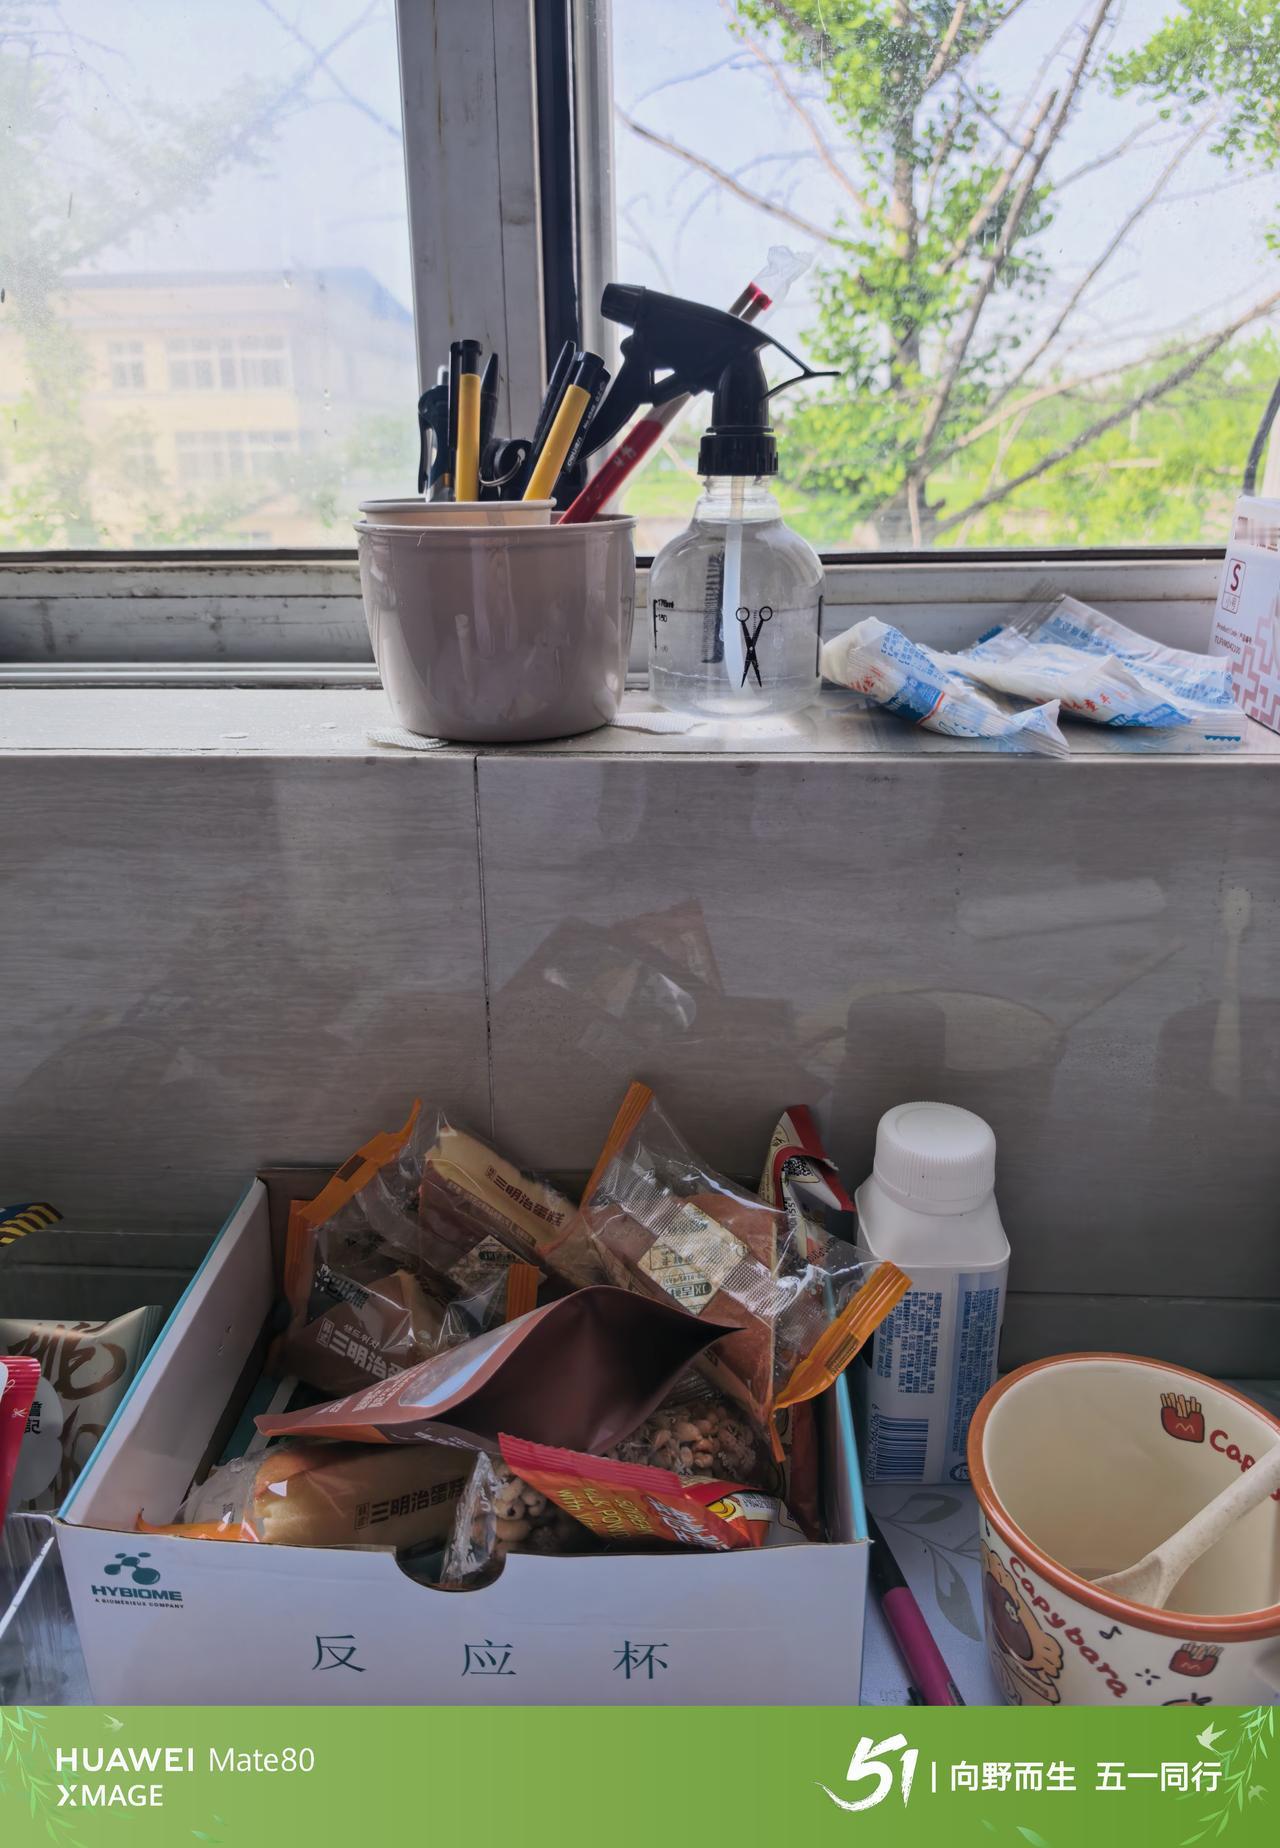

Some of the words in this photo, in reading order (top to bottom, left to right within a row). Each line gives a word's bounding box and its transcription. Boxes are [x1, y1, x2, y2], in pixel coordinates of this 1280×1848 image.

[1230, 563, 1241, 592] S
[91, 1585, 183, 1602] HYBIOME
[1009, 1556, 1128, 1699] Capybara
[311, 1634, 670, 1680] 反应杯
